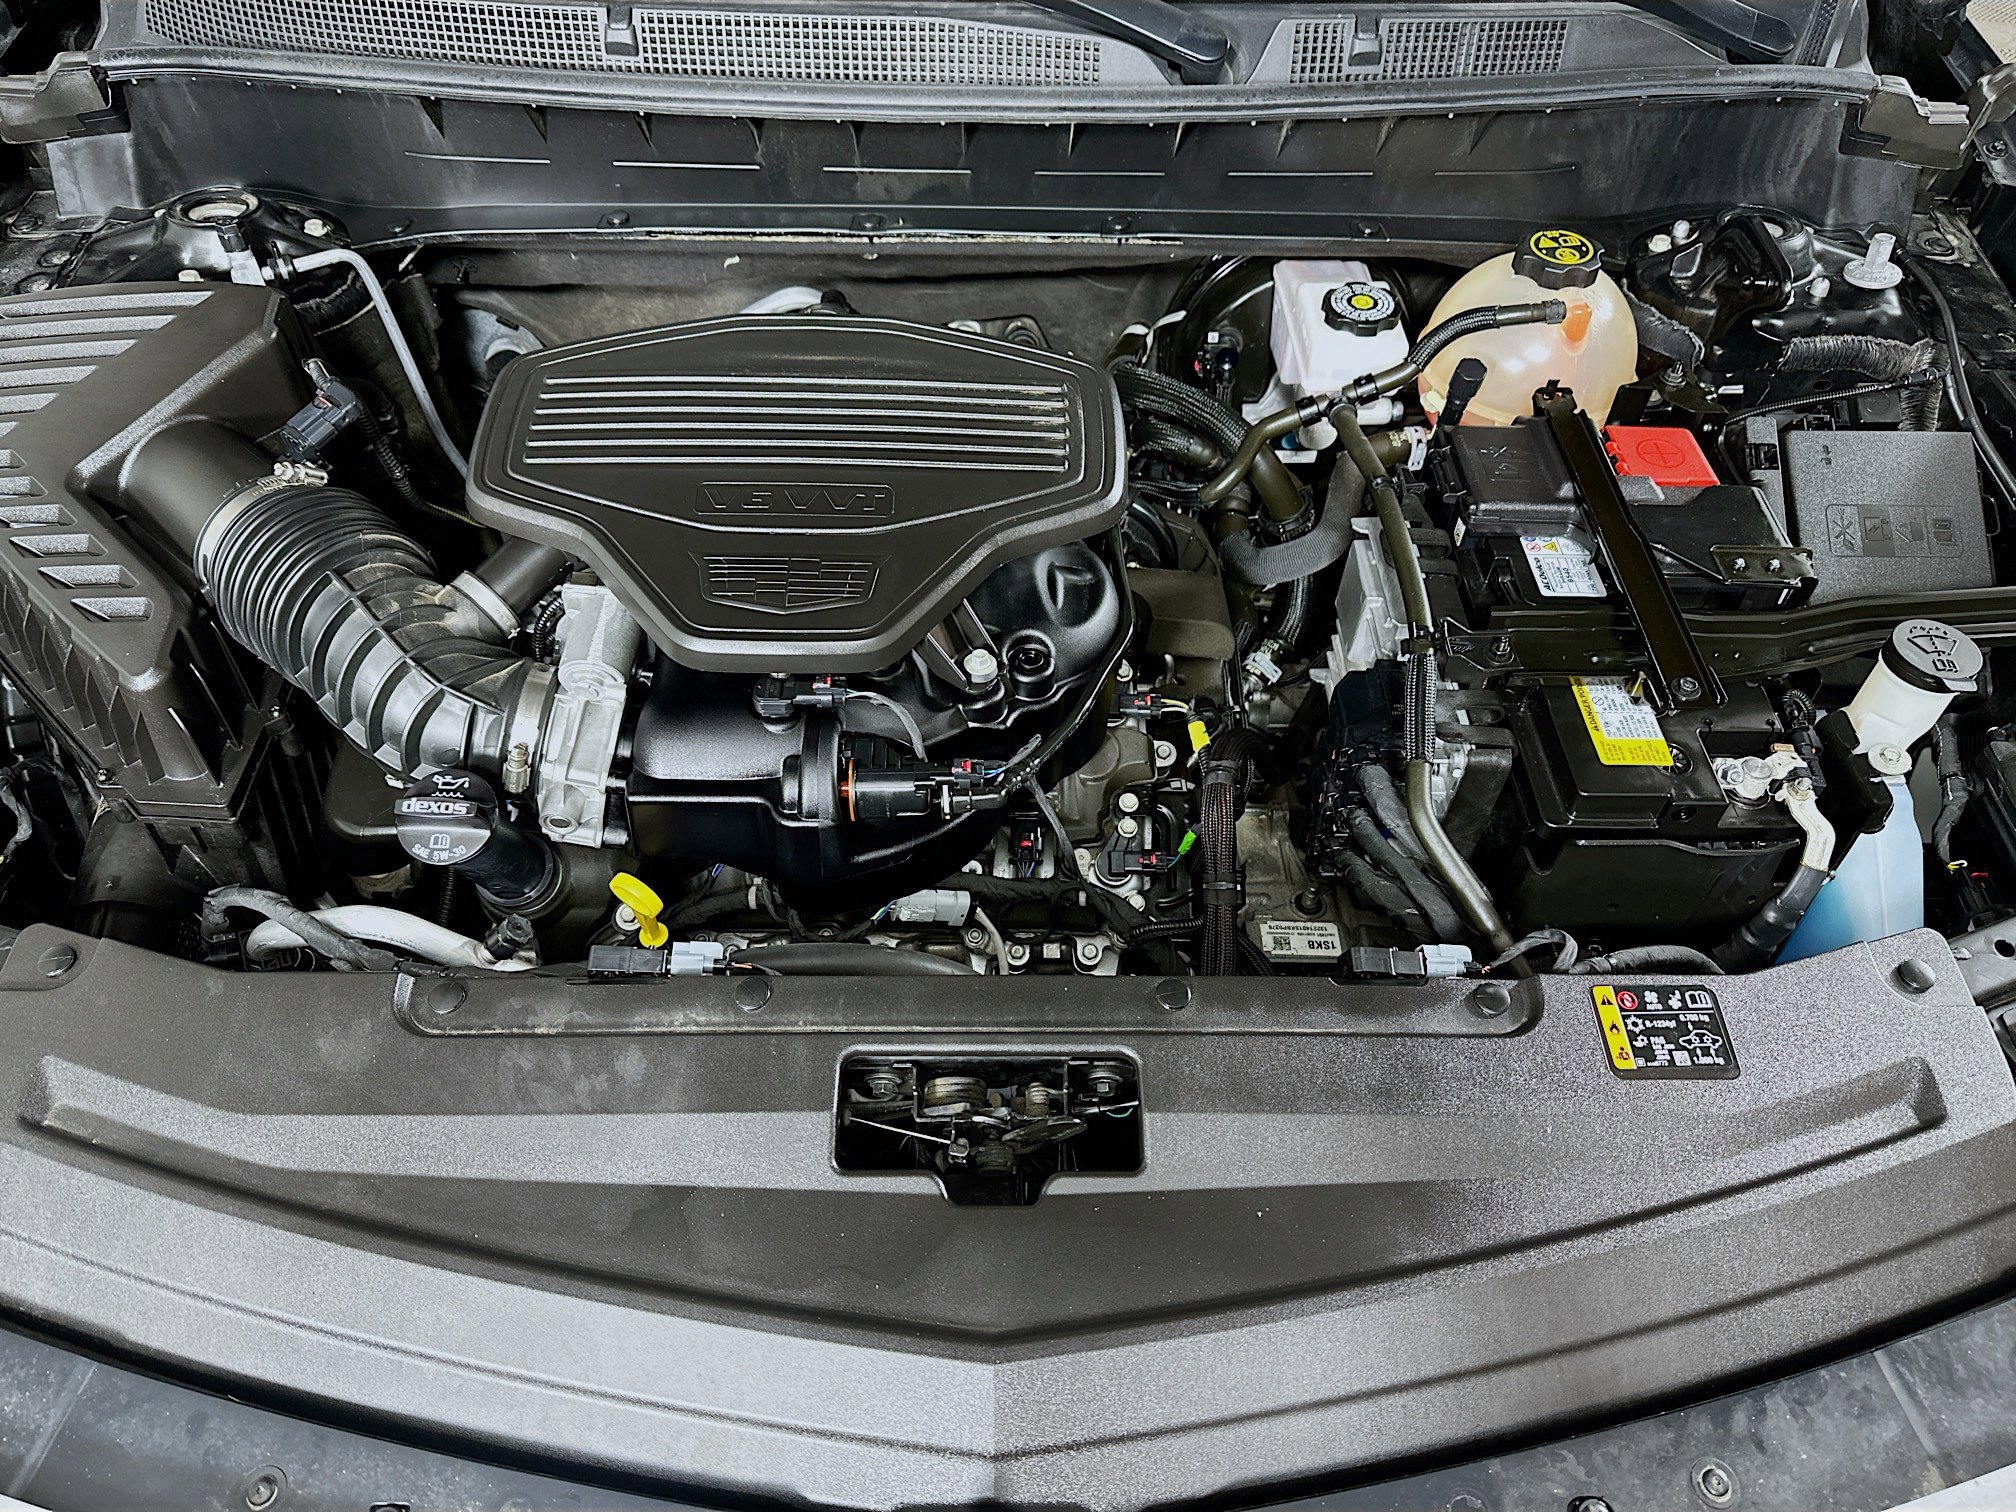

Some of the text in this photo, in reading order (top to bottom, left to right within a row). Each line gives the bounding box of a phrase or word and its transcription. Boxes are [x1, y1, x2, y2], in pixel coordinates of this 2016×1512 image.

[705, 489, 886, 510] V6 VVT
[1534, 557, 1551, 592] ACDelco
[402, 797, 471, 815] dexos
[411, 843, 467, 862] SAE 5W-30
[1307, 940, 1337, 950] 1SKB
